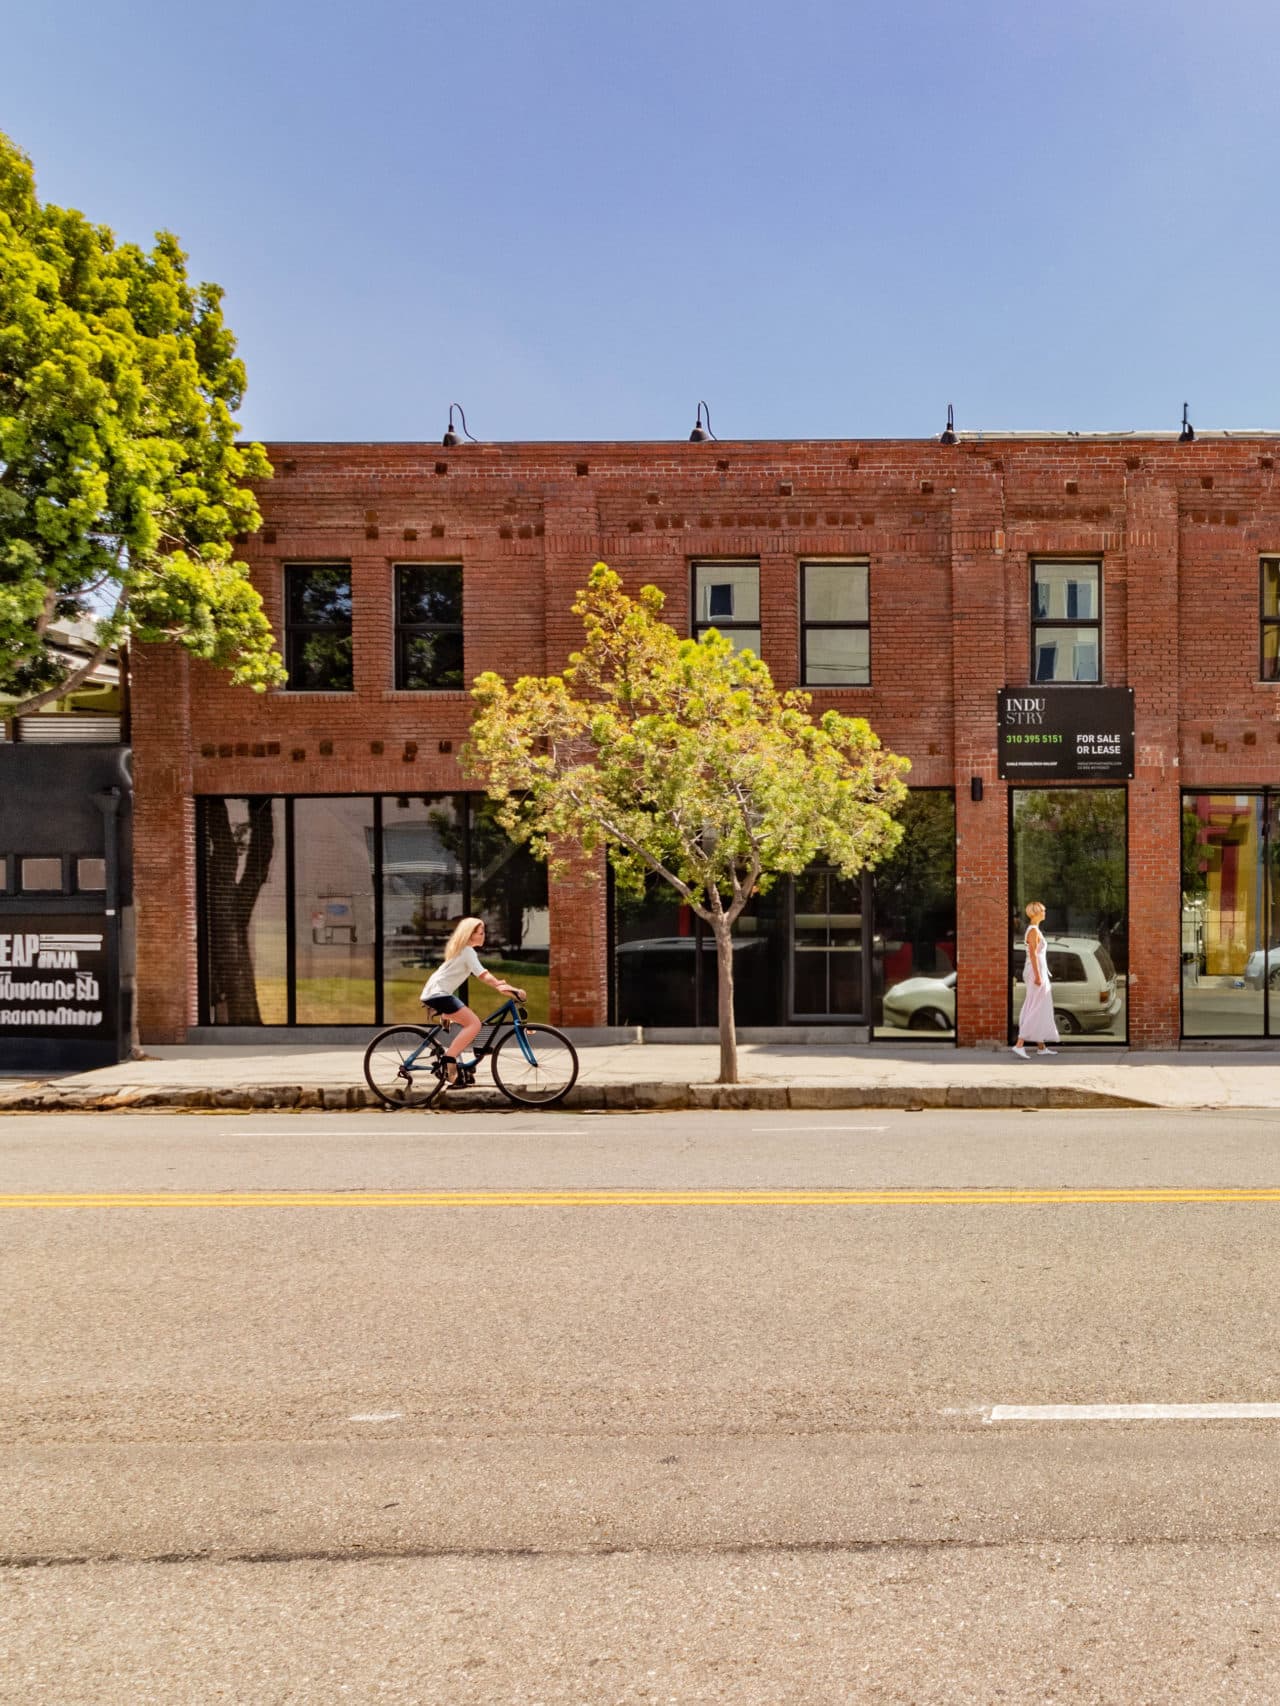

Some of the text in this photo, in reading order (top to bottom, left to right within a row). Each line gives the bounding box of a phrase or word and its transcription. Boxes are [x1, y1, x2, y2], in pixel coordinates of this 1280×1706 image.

[1006, 698, 1046, 711] INDU
[1006, 712, 1045, 725] STRY
[1006, 735, 1063, 743] 310 395 5151
[1076, 734, 1121, 743] FOR SALE
[1076, 745, 1121, 754] OR LEASE
